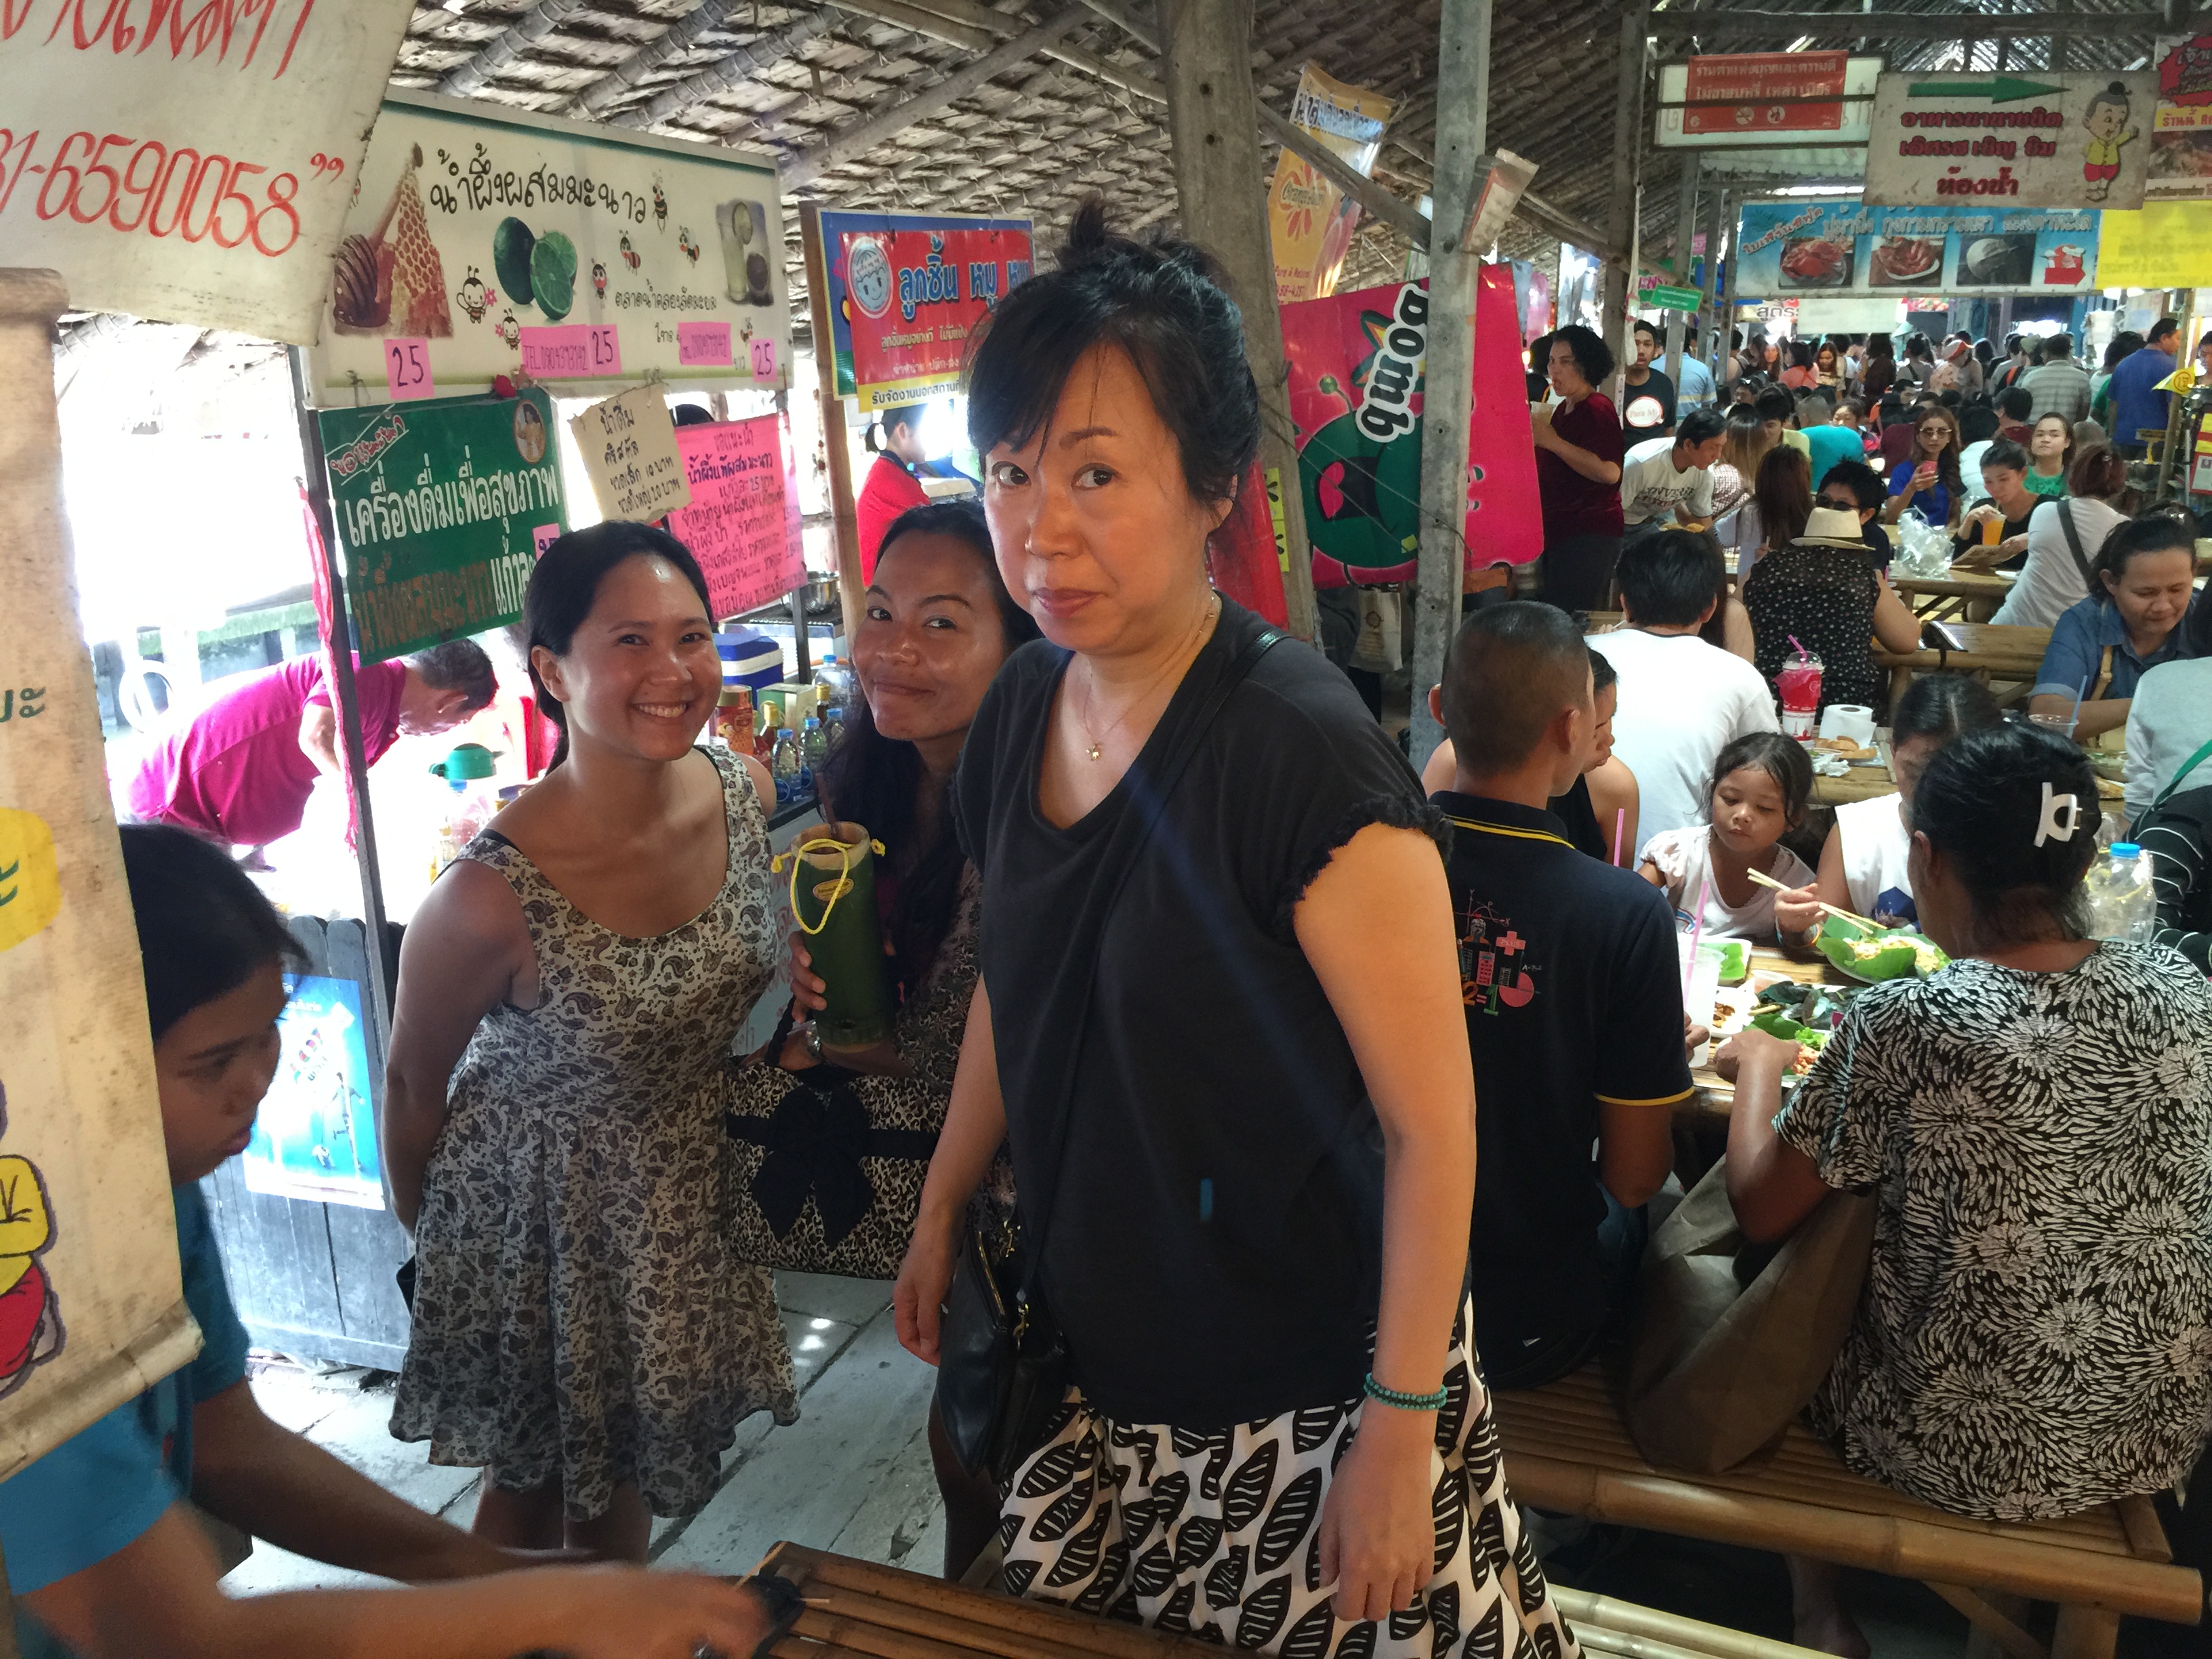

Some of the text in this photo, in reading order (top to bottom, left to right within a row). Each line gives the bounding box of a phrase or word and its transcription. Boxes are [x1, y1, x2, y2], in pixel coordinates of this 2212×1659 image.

[430, 142, 646, 224] น้ำผึ้งผสมมะนาว
[1936, 165, 2020, 196] ห้องน้ำ
[898, 234, 960, 321] ลูกชิ้น
[391, 344, 425, 387] 25
[592, 330, 614, 365] 25
[754, 342, 772, 375] 25
[872, 380, 961, 405] รับจัดงานนอกสถานท
[330, 412, 406, 476] ขอแนะนำ
[345, 445, 559, 548] เครื่องดื่มเพื่อสุขภาพ
